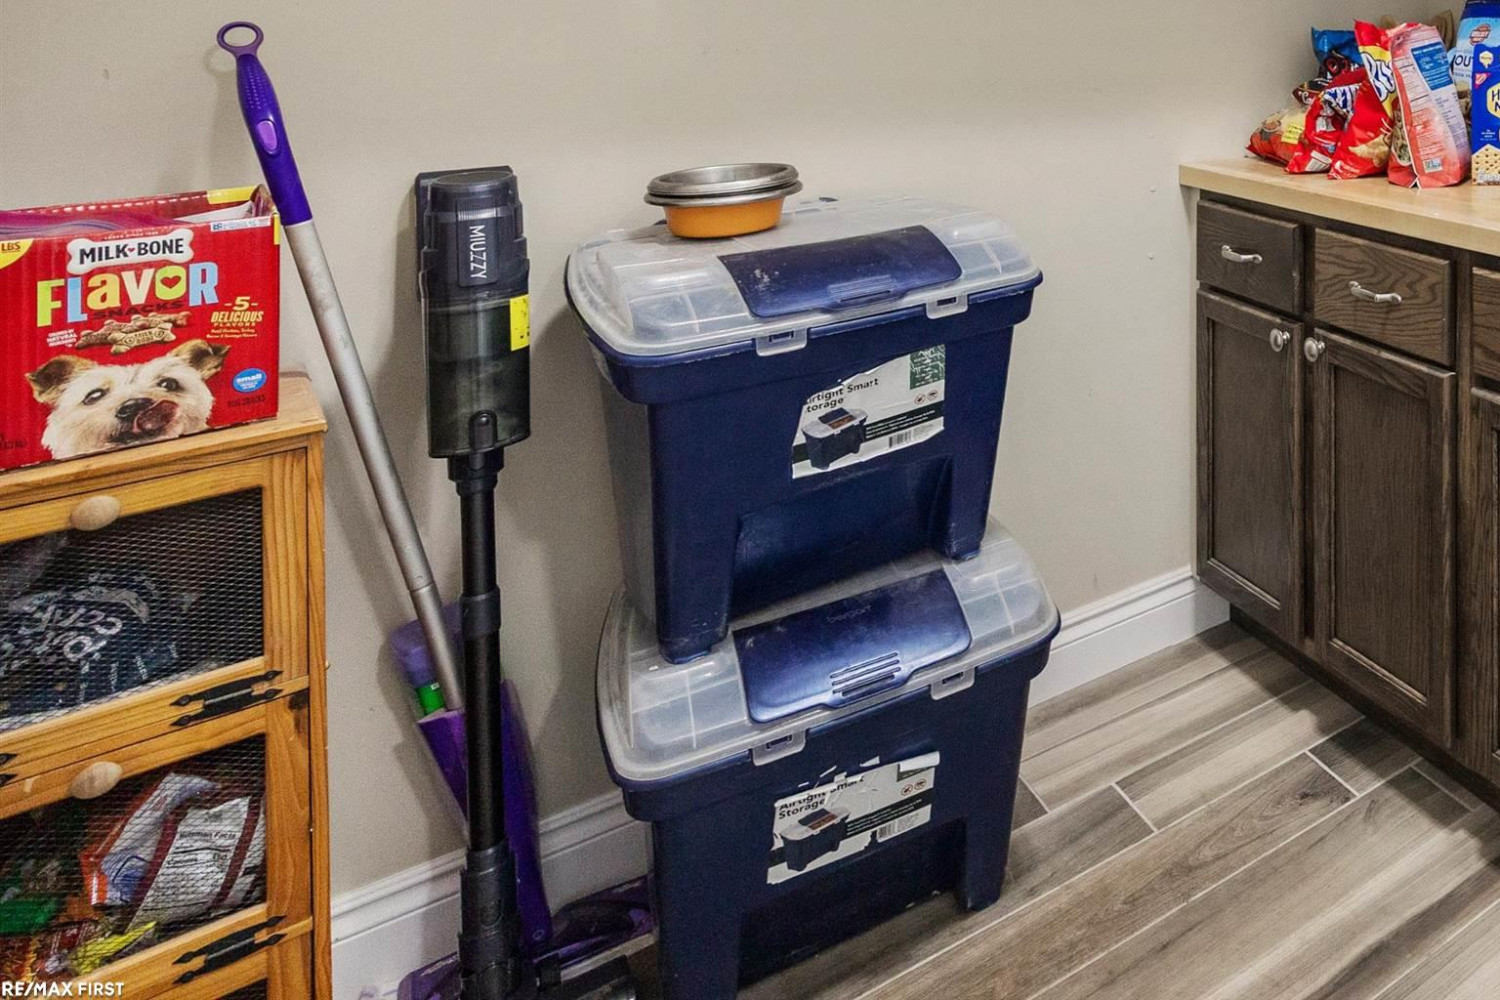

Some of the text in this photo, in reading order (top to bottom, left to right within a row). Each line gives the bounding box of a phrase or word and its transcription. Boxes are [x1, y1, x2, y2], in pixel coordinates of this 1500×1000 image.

[469, 224, 487, 279] MIUZZY
[93, 300, 184, 320] SNACKS
[211, 310, 264, 323] DELICIOUS
[847, 378, 879, 394] Smart
[806, 397, 845, 413] torage
[778, 798, 826, 820] Storage
